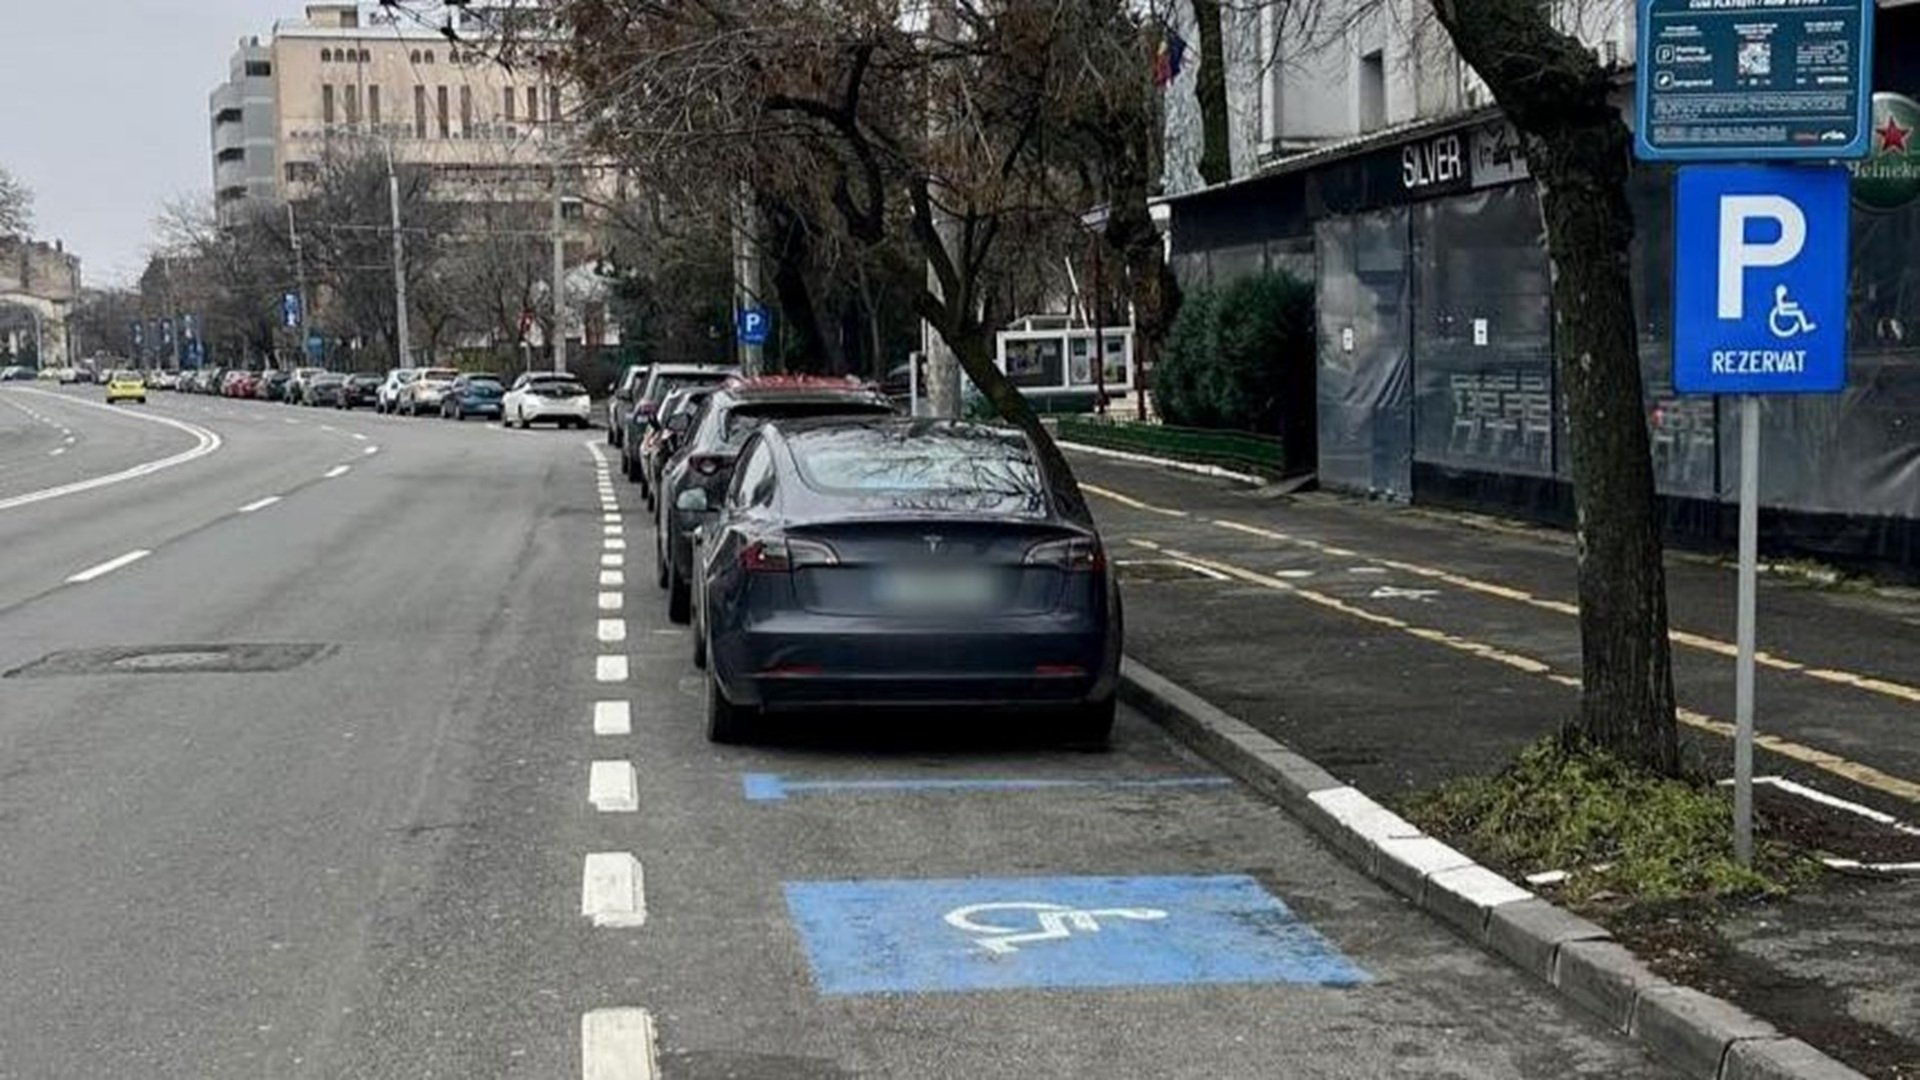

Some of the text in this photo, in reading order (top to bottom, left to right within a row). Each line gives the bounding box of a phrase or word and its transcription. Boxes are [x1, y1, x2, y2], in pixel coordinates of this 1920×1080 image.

[1402, 135, 1461, 188] SILVER
[1718, 194, 1807, 319] P
[746, 313, 760, 332] P
[1711, 350, 1807, 374] REZERVAT
